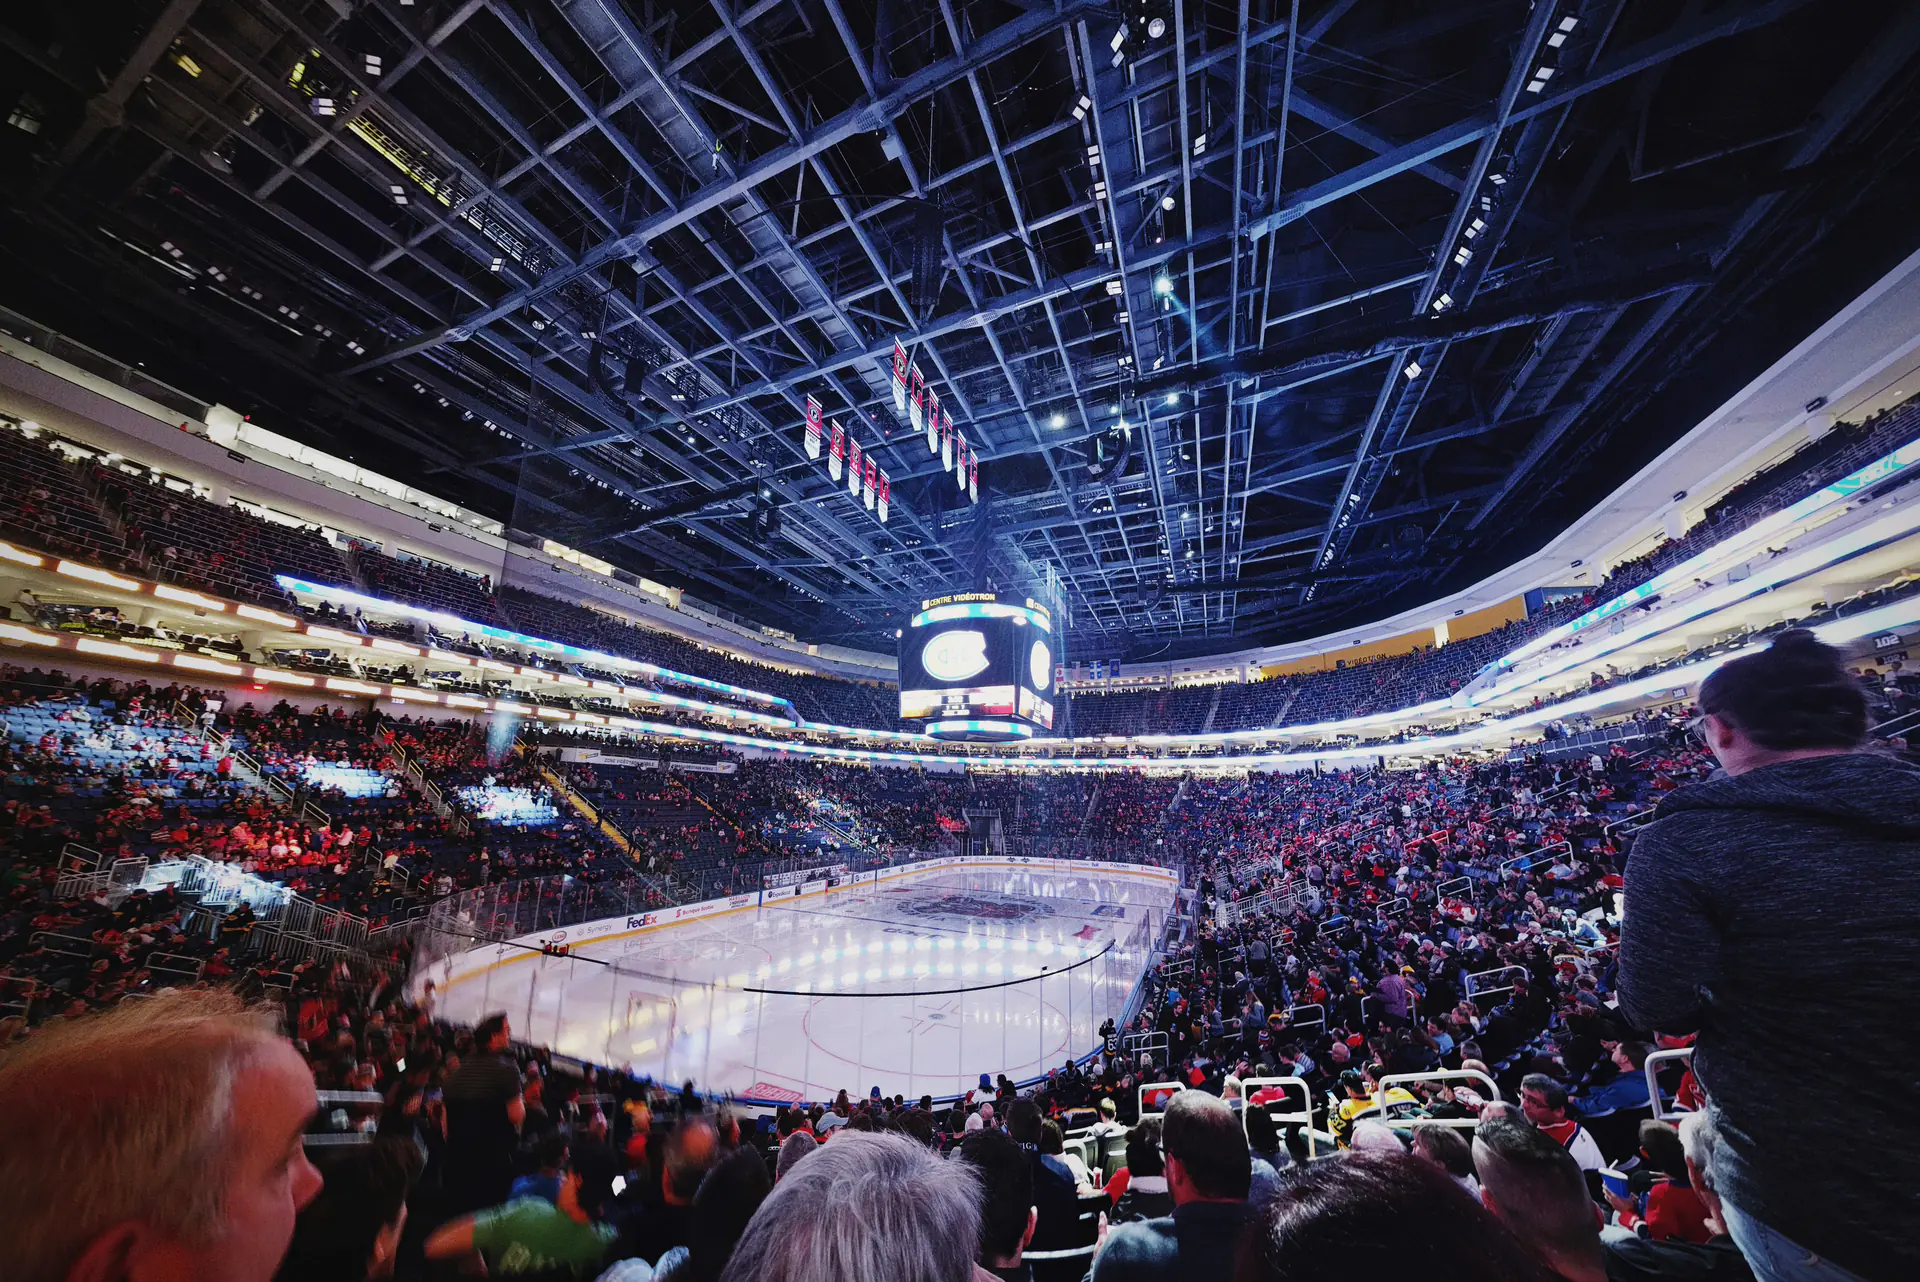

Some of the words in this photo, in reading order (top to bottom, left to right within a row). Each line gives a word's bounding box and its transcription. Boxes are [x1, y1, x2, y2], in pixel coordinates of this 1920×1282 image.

[930, 596, 952, 606] CENTRE
[953, 592, 996, 602] VIDÉOTRON
[1875, 635, 1900, 648] 102
[1883, 653, 1901, 664] 102
[1673, 688, 1686, 697] 101
[627, 914, 658, 929] FedEx
[587, 924, 613, 935] Synergy
